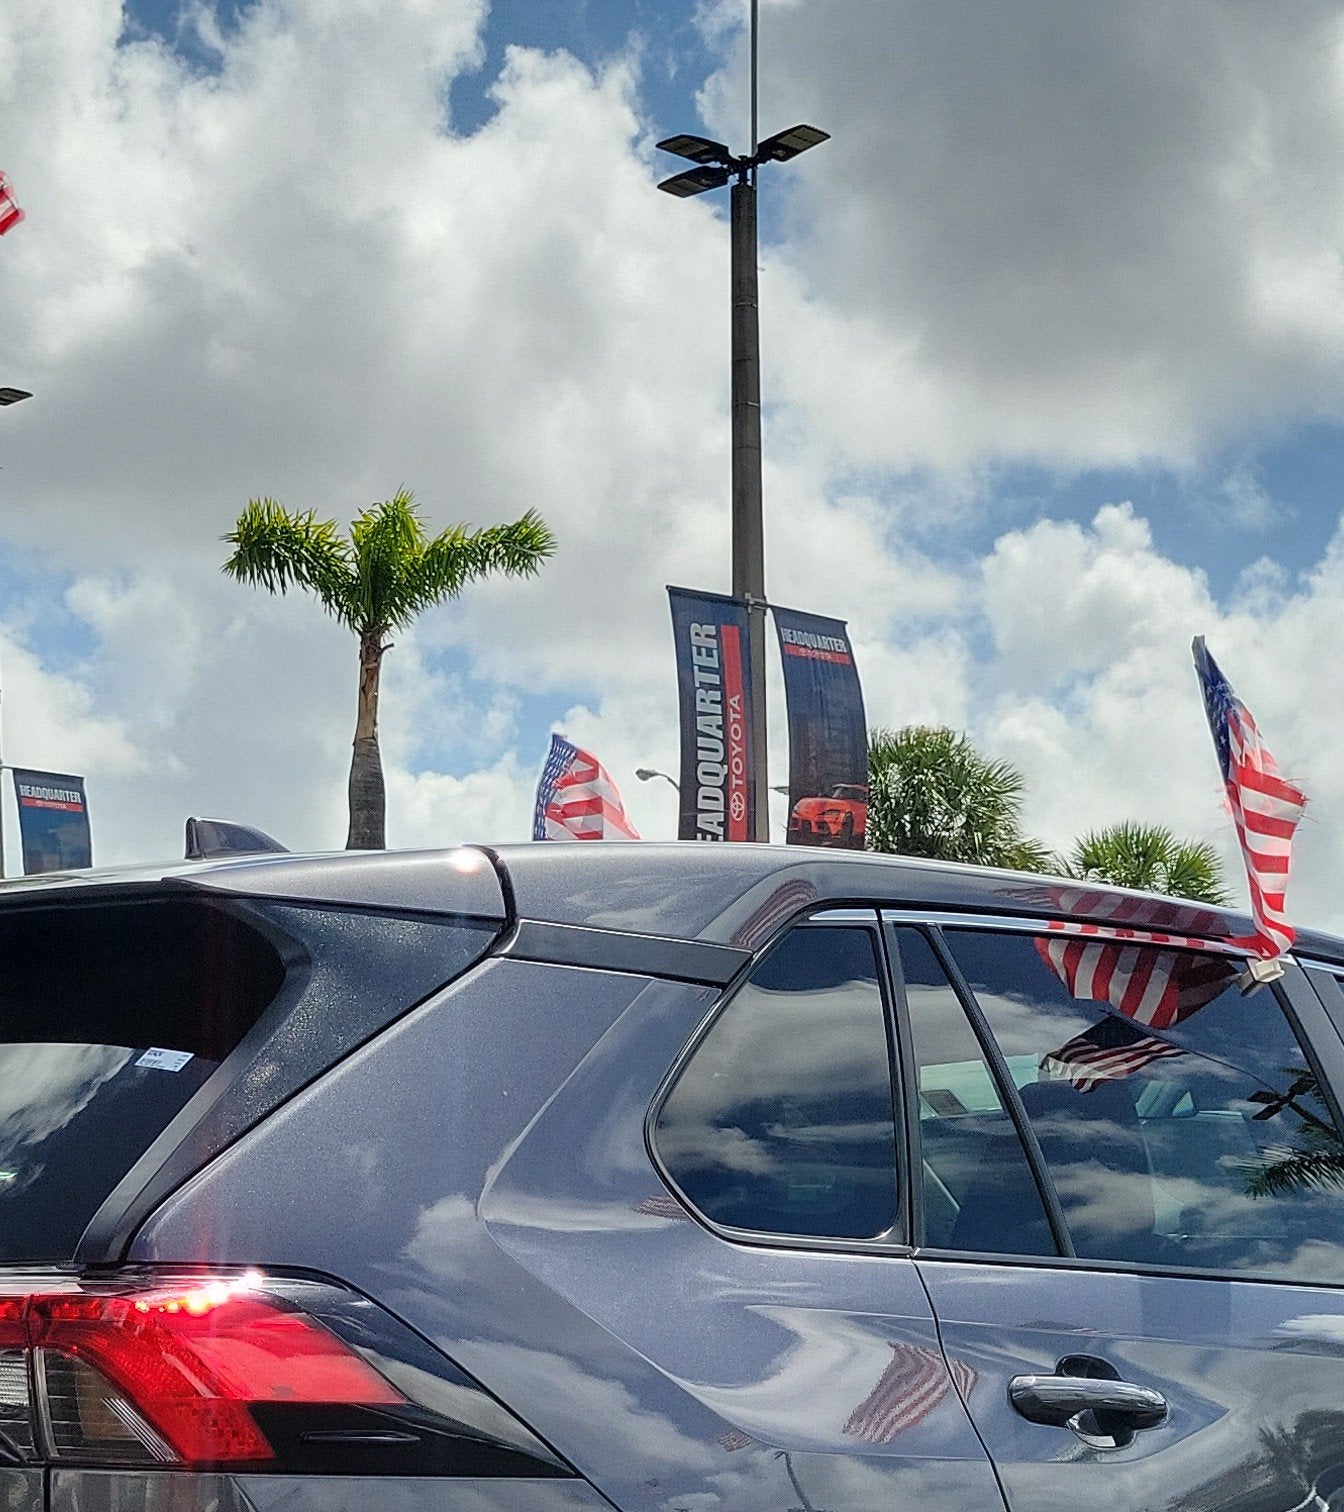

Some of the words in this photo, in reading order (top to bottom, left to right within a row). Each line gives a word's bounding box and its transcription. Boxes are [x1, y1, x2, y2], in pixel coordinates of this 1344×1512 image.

[780, 627, 847, 653] HEADQUARTER
[729, 694, 745, 788] TOYOTA
[19, 785, 82, 803] HEADQUARTER
